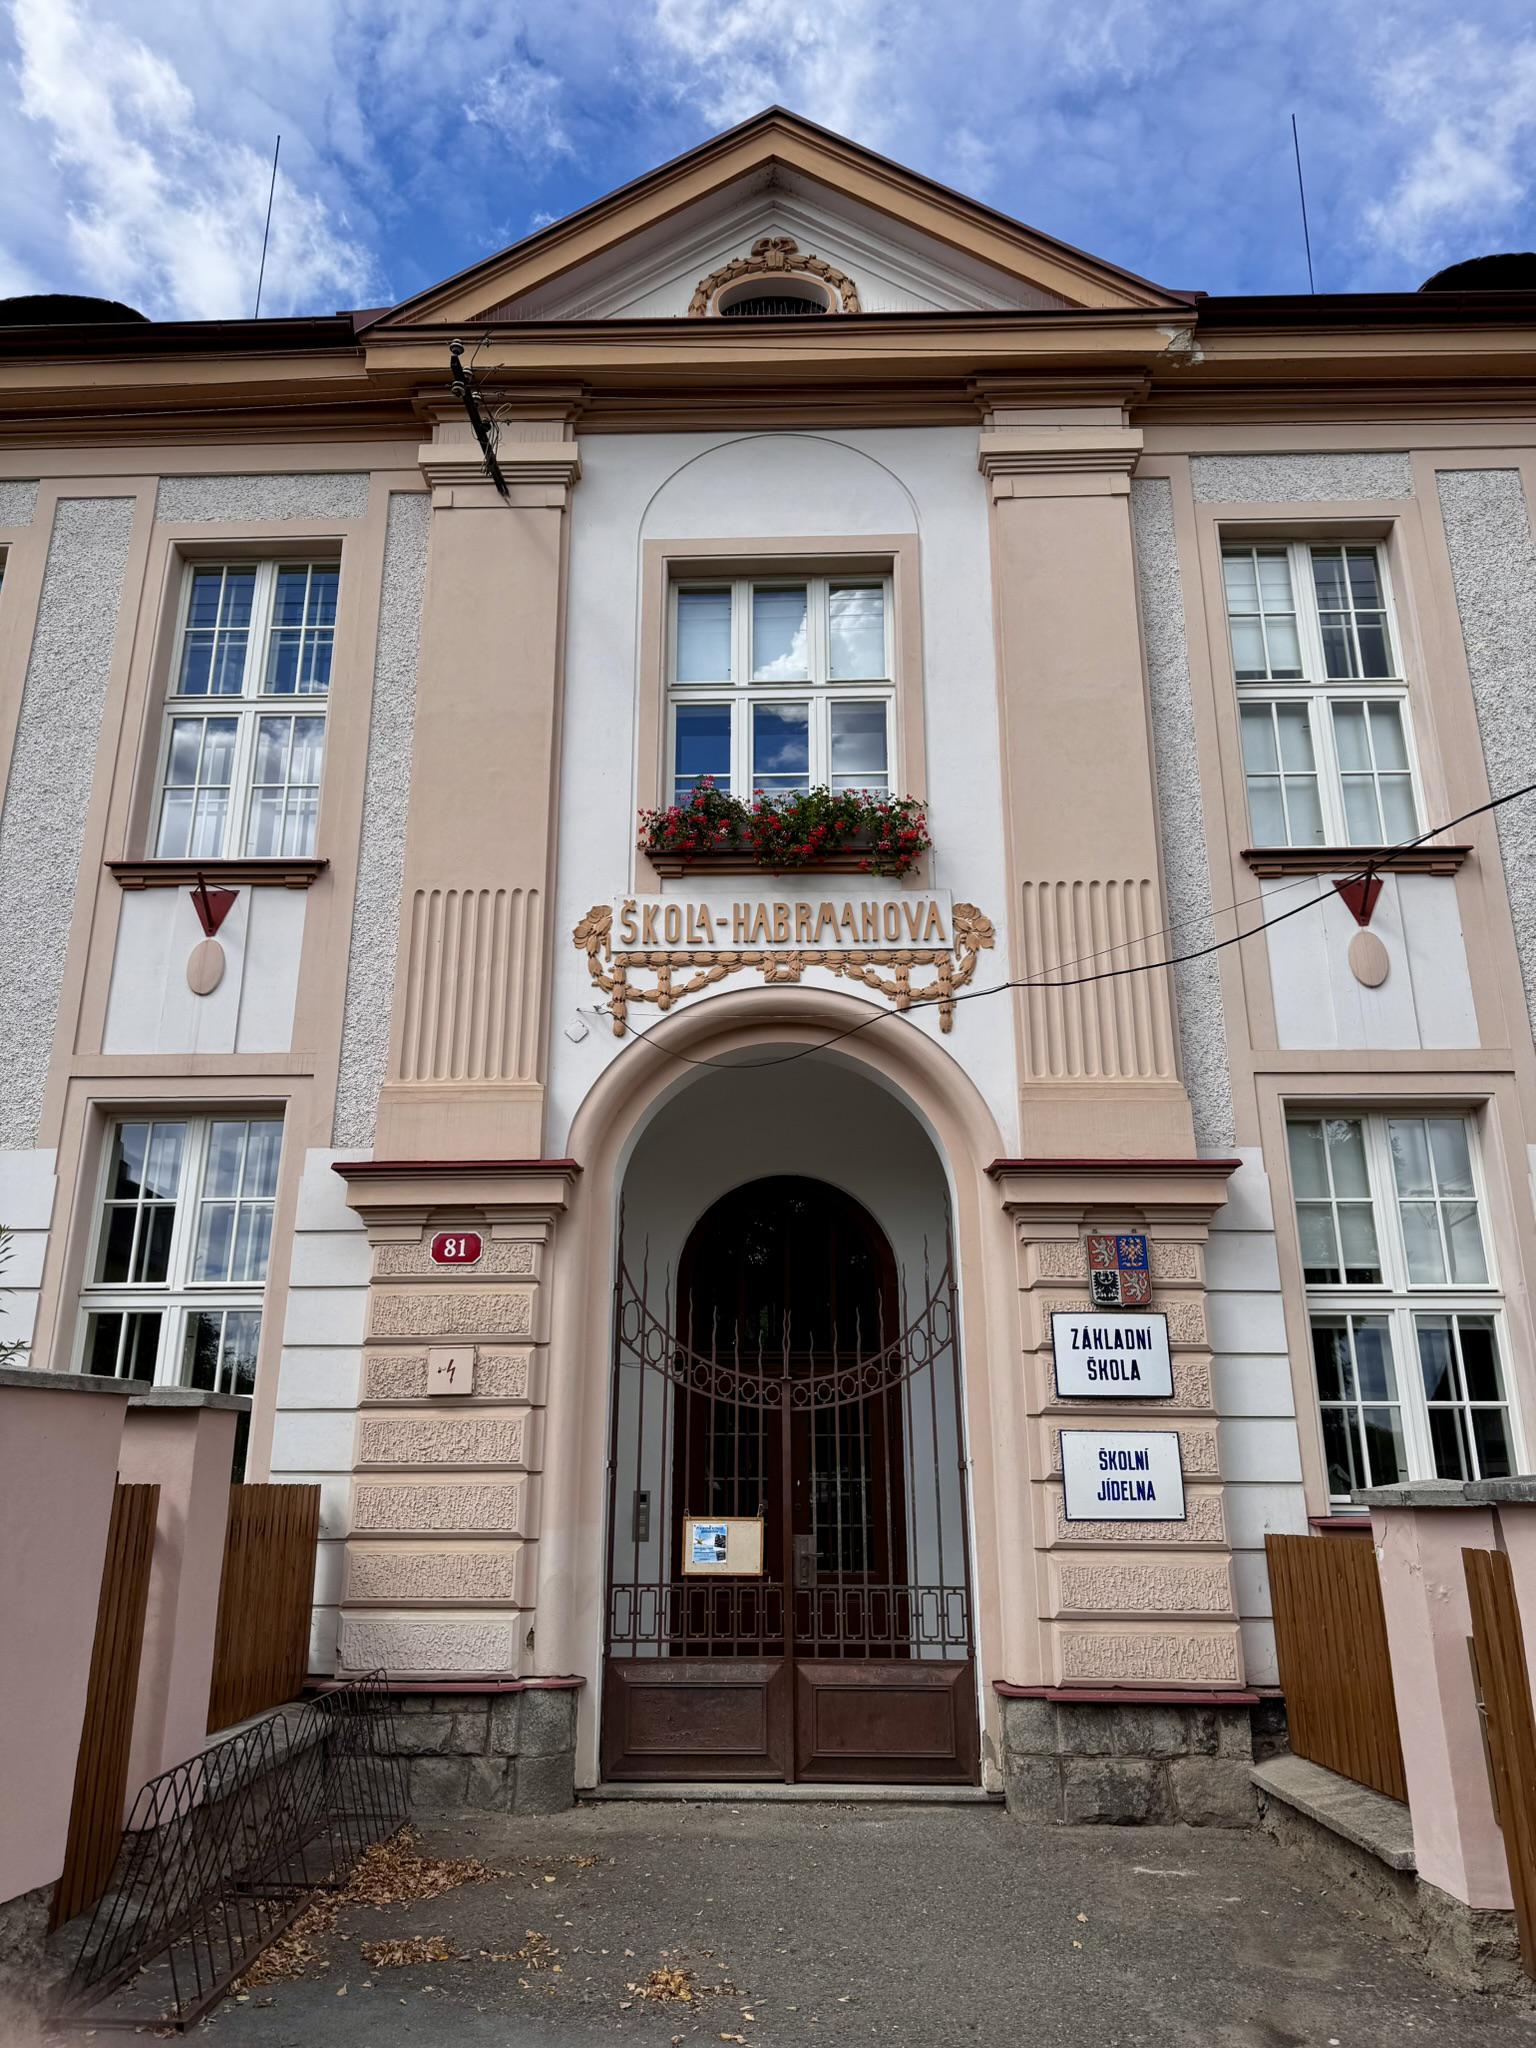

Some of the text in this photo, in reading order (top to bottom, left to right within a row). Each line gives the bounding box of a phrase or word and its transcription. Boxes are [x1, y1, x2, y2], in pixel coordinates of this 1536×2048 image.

[444, 1238, 466, 1257] 81
[1071, 1326, 1152, 1350] ZÁKLADNÍ
[1087, 1356, 1141, 1381] ŠKOLA
[1099, 1448, 1149, 1471] ŠKOLNÍ
[1097, 1477, 1156, 1501] JÍDELNA
